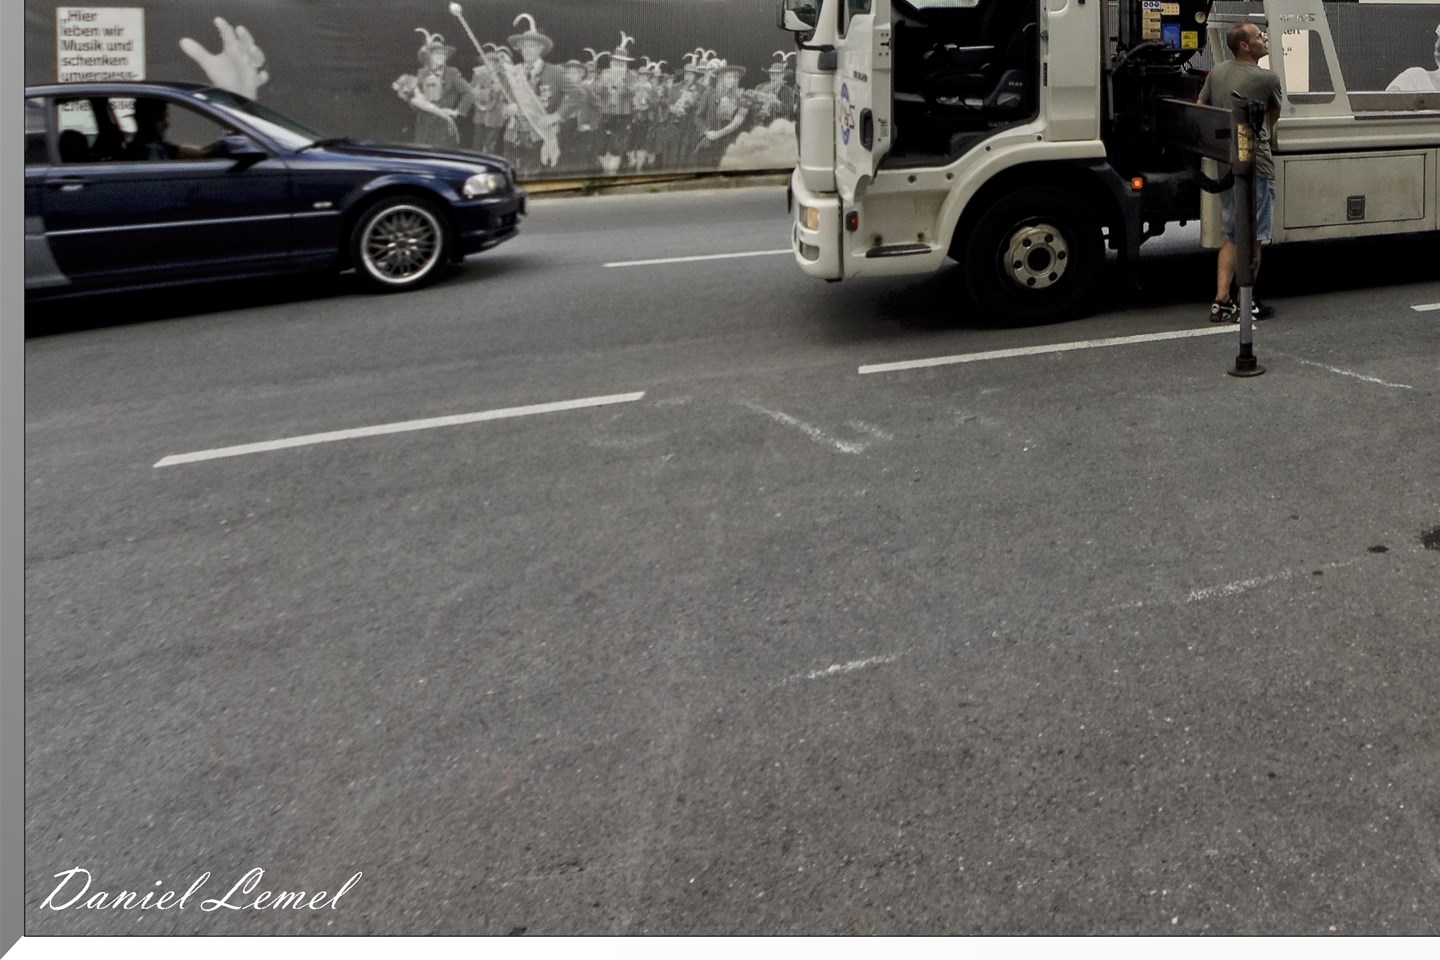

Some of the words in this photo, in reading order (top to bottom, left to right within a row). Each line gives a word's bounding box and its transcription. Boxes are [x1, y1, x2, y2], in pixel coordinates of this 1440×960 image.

[103, 24, 124, 37] wir
[62, 39, 102, 51] Musik
[106, 39, 133, 51] und
[61, 54, 129, 66] schenken
